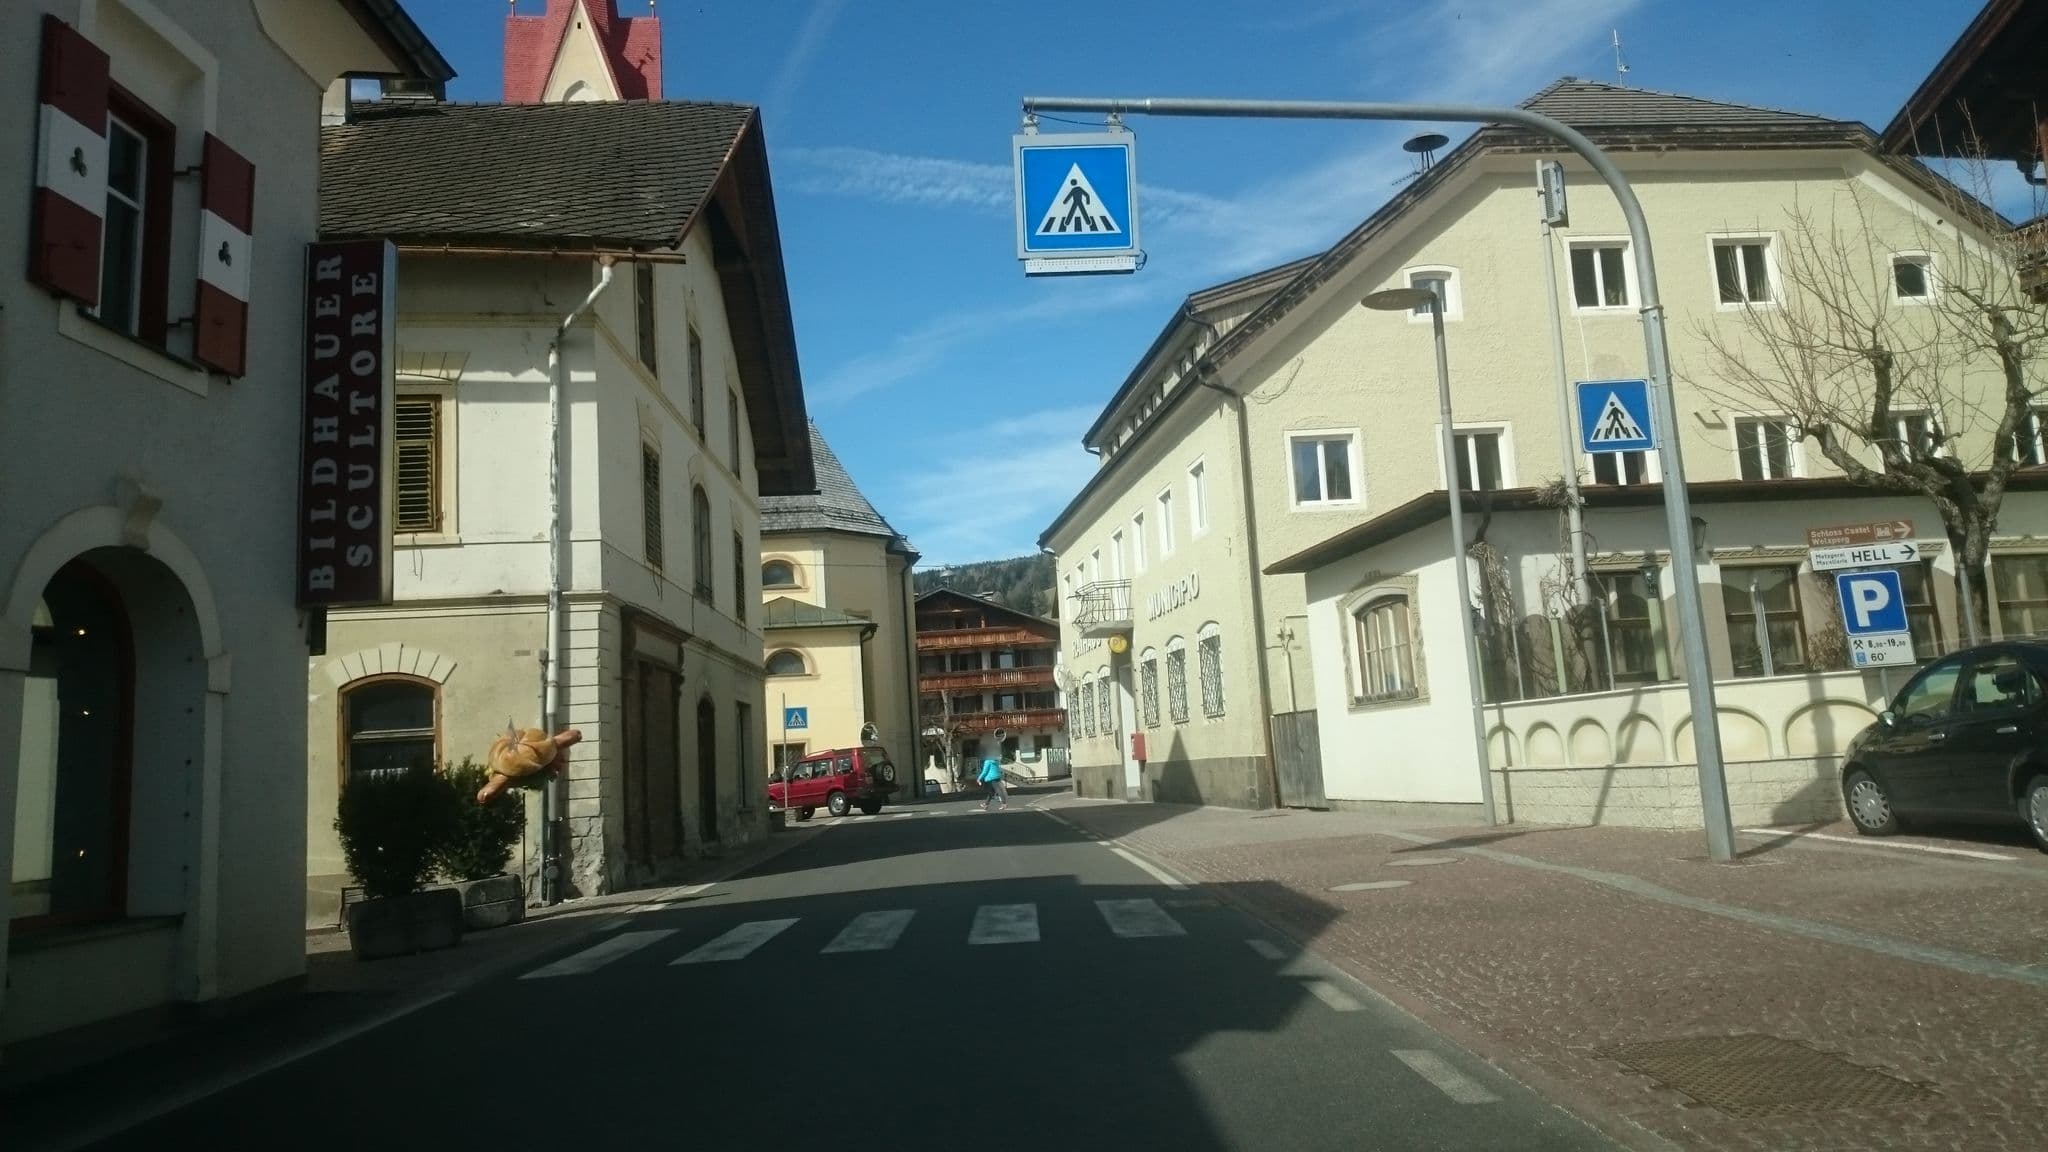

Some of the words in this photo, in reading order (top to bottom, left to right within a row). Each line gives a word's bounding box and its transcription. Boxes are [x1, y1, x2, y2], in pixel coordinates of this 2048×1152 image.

[309, 255, 343, 592] BILDHAUER
[346, 271, 378, 568] SCULTORE
[1811, 529, 1843, 538] Schloss
[1851, 549, 1891, 563] HELL
[1147, 570, 1200, 622] MUNICIPIO
[1850, 580, 1890, 627] P
